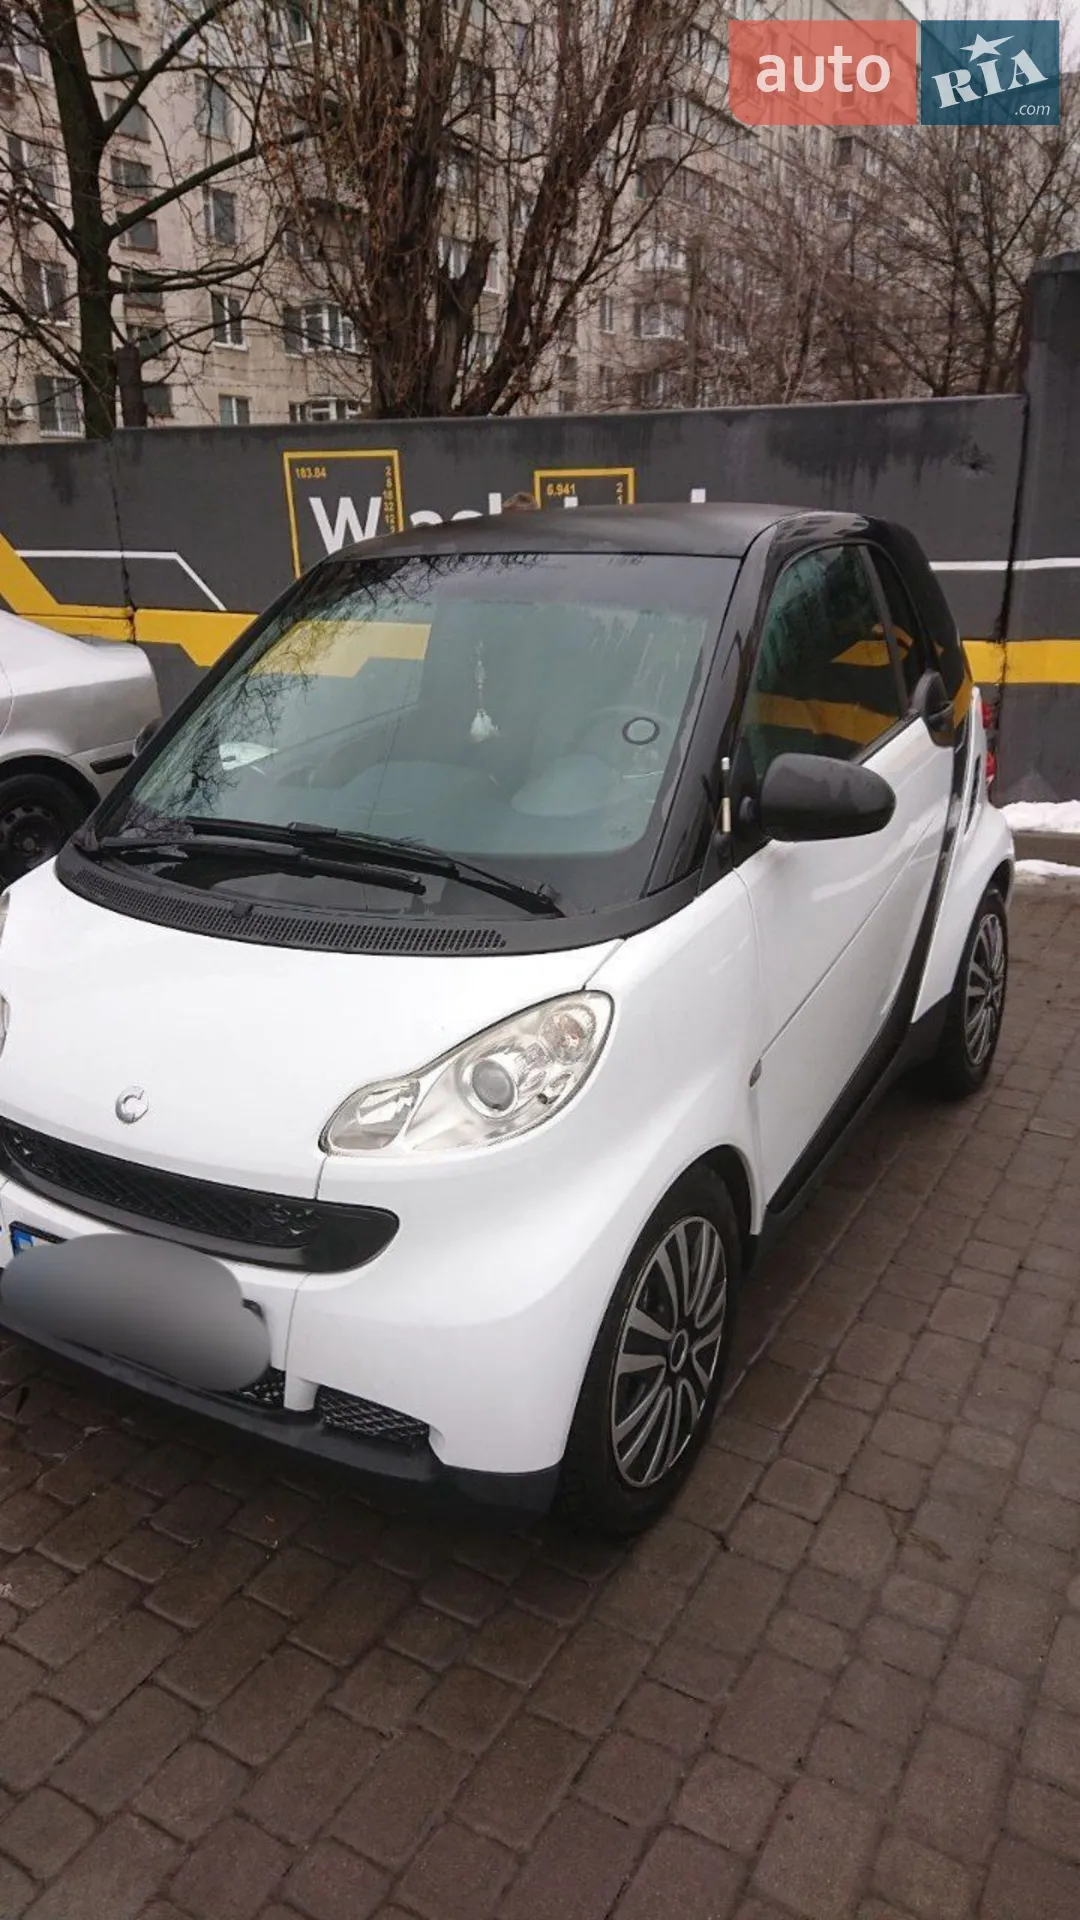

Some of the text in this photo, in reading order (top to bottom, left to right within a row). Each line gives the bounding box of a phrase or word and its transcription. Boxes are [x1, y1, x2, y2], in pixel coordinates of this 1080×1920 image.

[385, 465, 392, 477] 2
[546, 482, 576, 496] 6.941
[615, 481, 624, 493] 2
